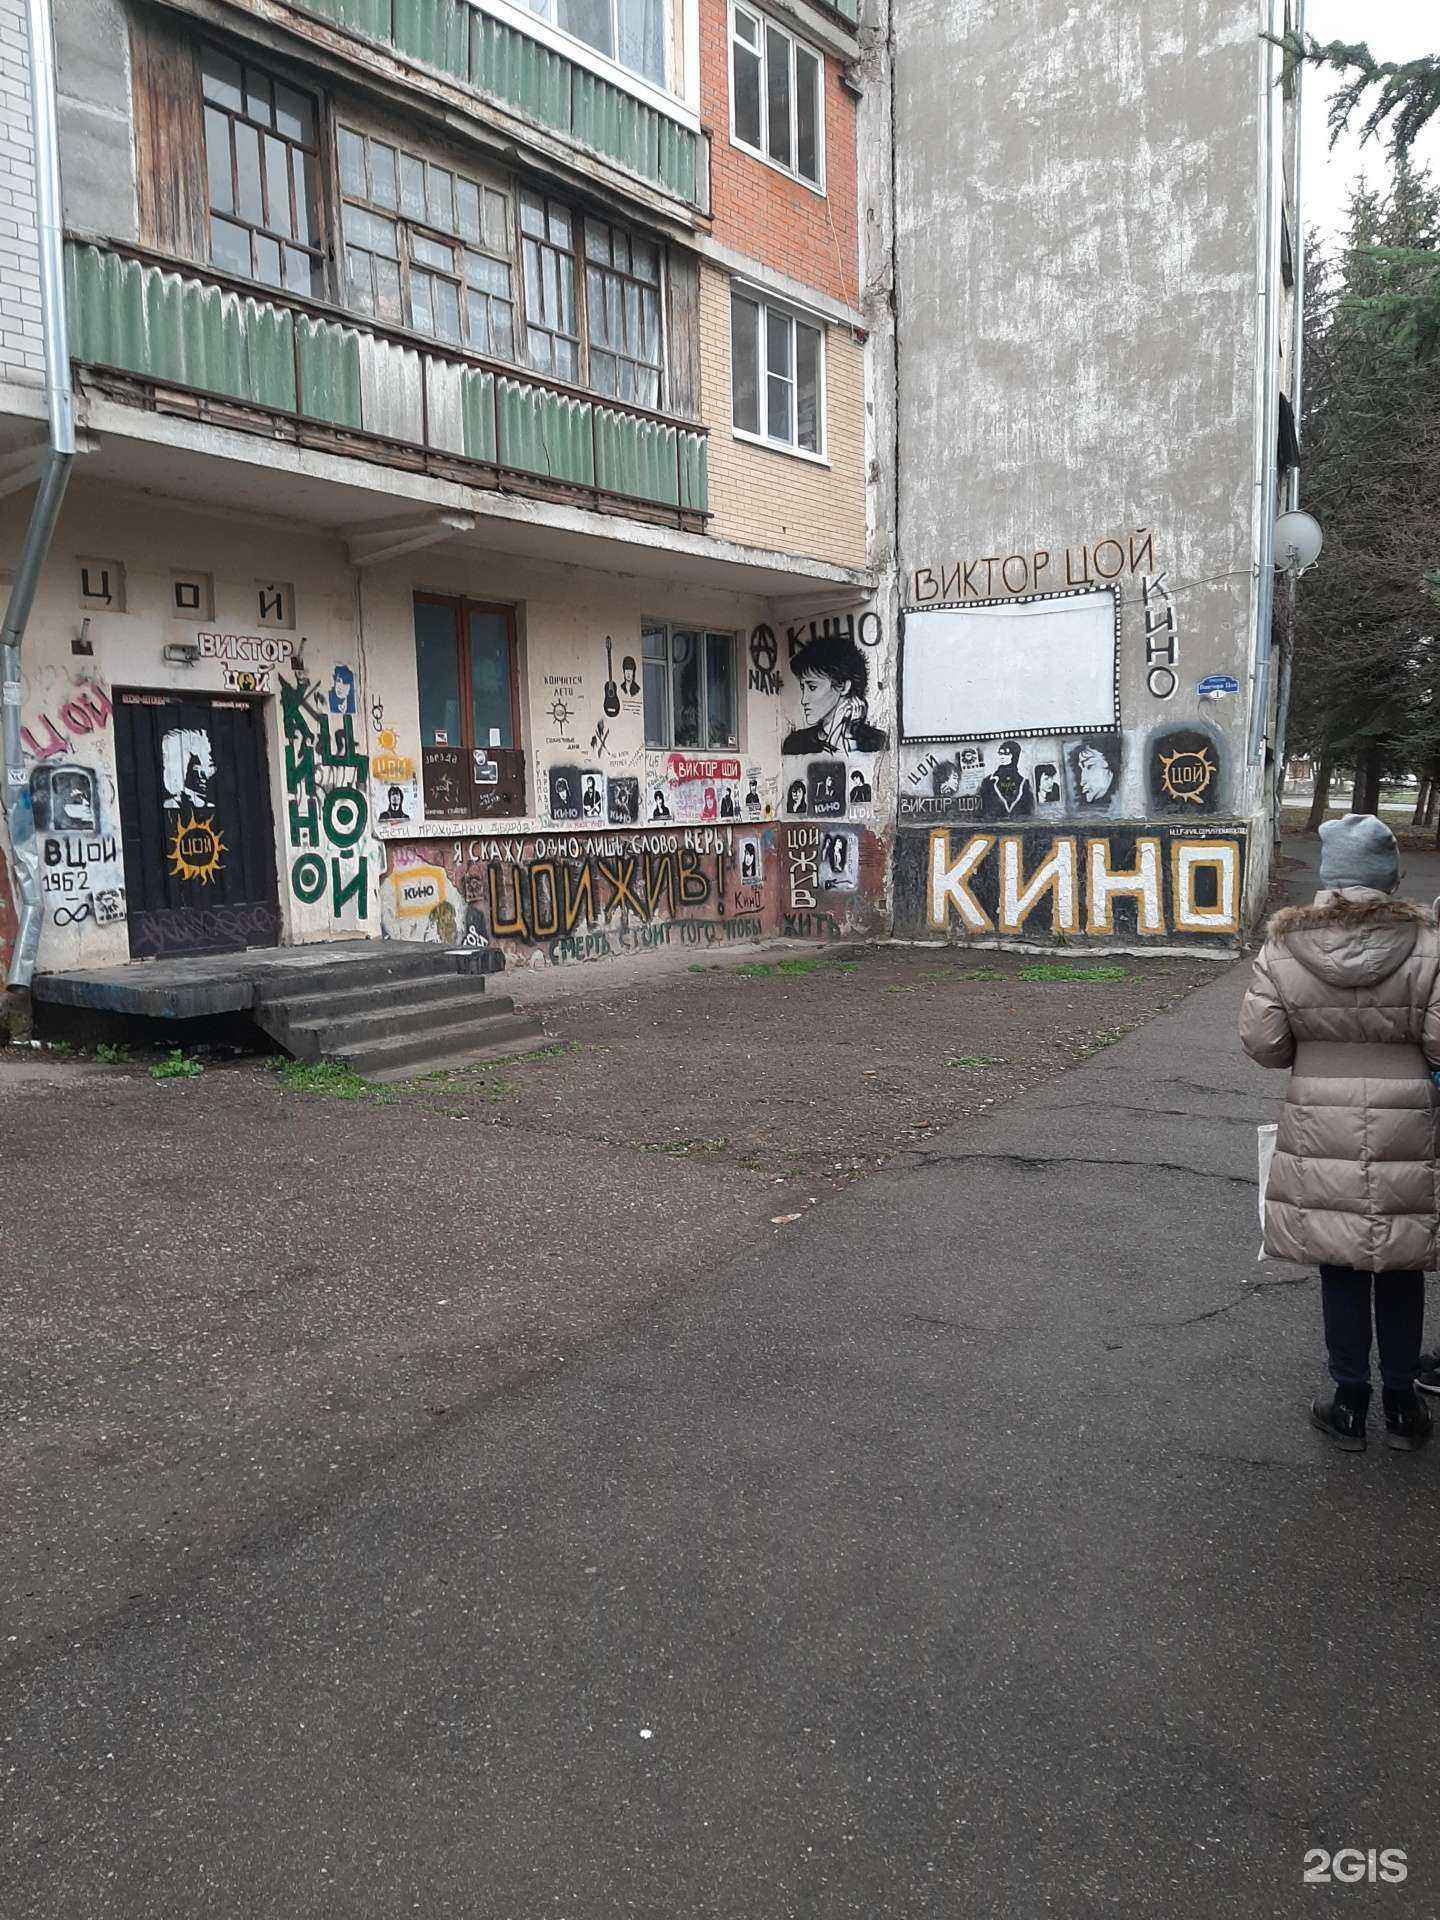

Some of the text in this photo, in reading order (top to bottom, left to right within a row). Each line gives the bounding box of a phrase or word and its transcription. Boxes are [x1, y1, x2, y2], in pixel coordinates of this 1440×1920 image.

[914, 528, 1155, 601] ВИКТОР ЦОЙ
[198, 632, 294, 663] ВИКТОР
[1143, 573, 1179, 700] КИНО
[678, 761, 717, 777] ВИКТОР
[907, 752, 939, 786] ЦОЙ
[1172, 763, 1203, 784] ЦОЙ
[320, 713, 370, 920] ЦОЙ
[553, 808, 578, 819] КИНО
[814, 801, 841, 815] КИНО
[901, 794, 983, 814] ВИКТОР ЦОЙ
[454, 841, 463, 865] Я
[631, 832, 678, 855] СЛОВО
[787, 828, 820, 850] ЦОЙ
[42, 871, 91, 892] 1962
[404, 884, 435, 901] КИНО
[789, 850, 818, 909] ЖИВ
[927, 827, 1240, 935] КИНО
[679, 919, 716, 944] ТОГО
[724, 918, 762, 940] ЧТОБЫ
